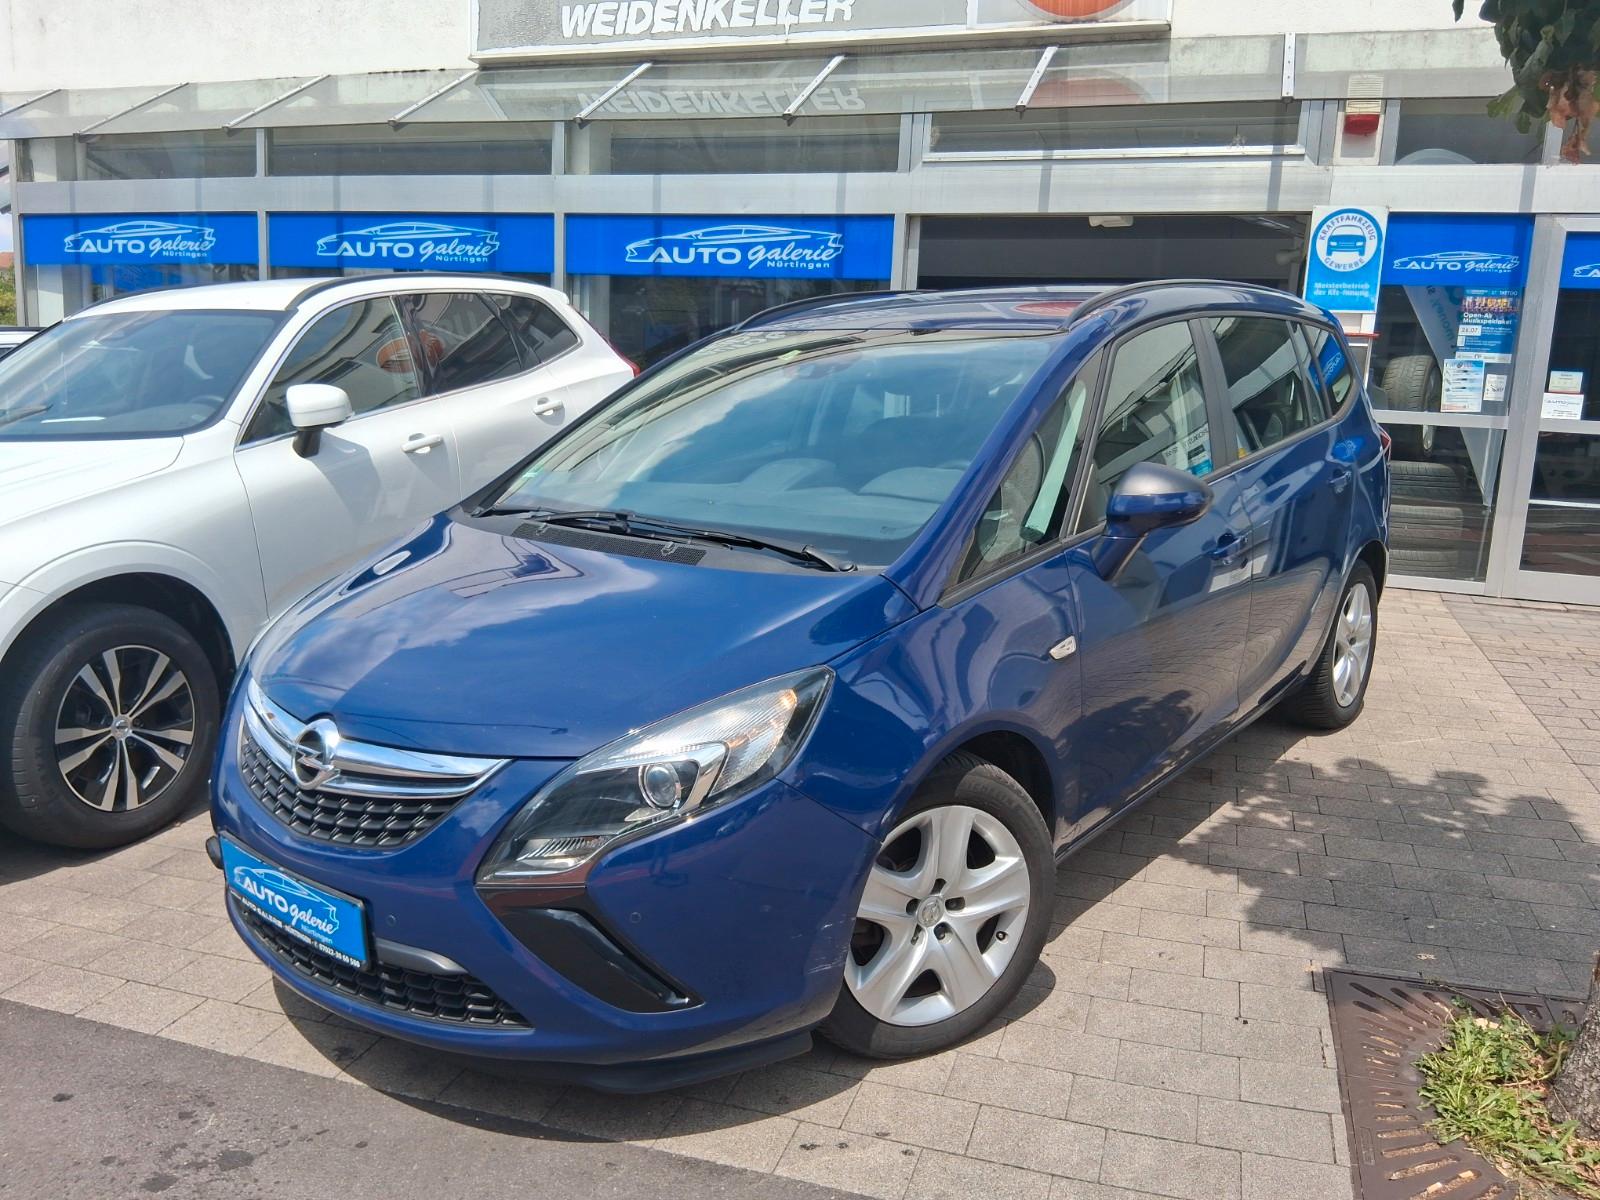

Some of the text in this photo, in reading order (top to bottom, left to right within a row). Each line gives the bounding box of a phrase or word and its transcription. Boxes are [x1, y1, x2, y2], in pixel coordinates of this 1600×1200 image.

[562, 0, 855, 38] WEIDENKELLER
[1319, 215, 1376, 241] KRAFTFAHRZEUG
[80, 235, 212, 258] AUTO galerie
[162, 250, 207, 259] Nürtingen
[336, 238, 493, 262] AUTO galerie
[648, 242, 837, 269] AUTO galerie
[436, 255, 488, 263] Nürtingen
[767, 261, 830, 270] Nürtingen
[1323, 256, 1366, 270] GEWERBE
[1408, 258, 1516, 273] AUTO galerie
[243, 876, 336, 934] AUTO galerie
